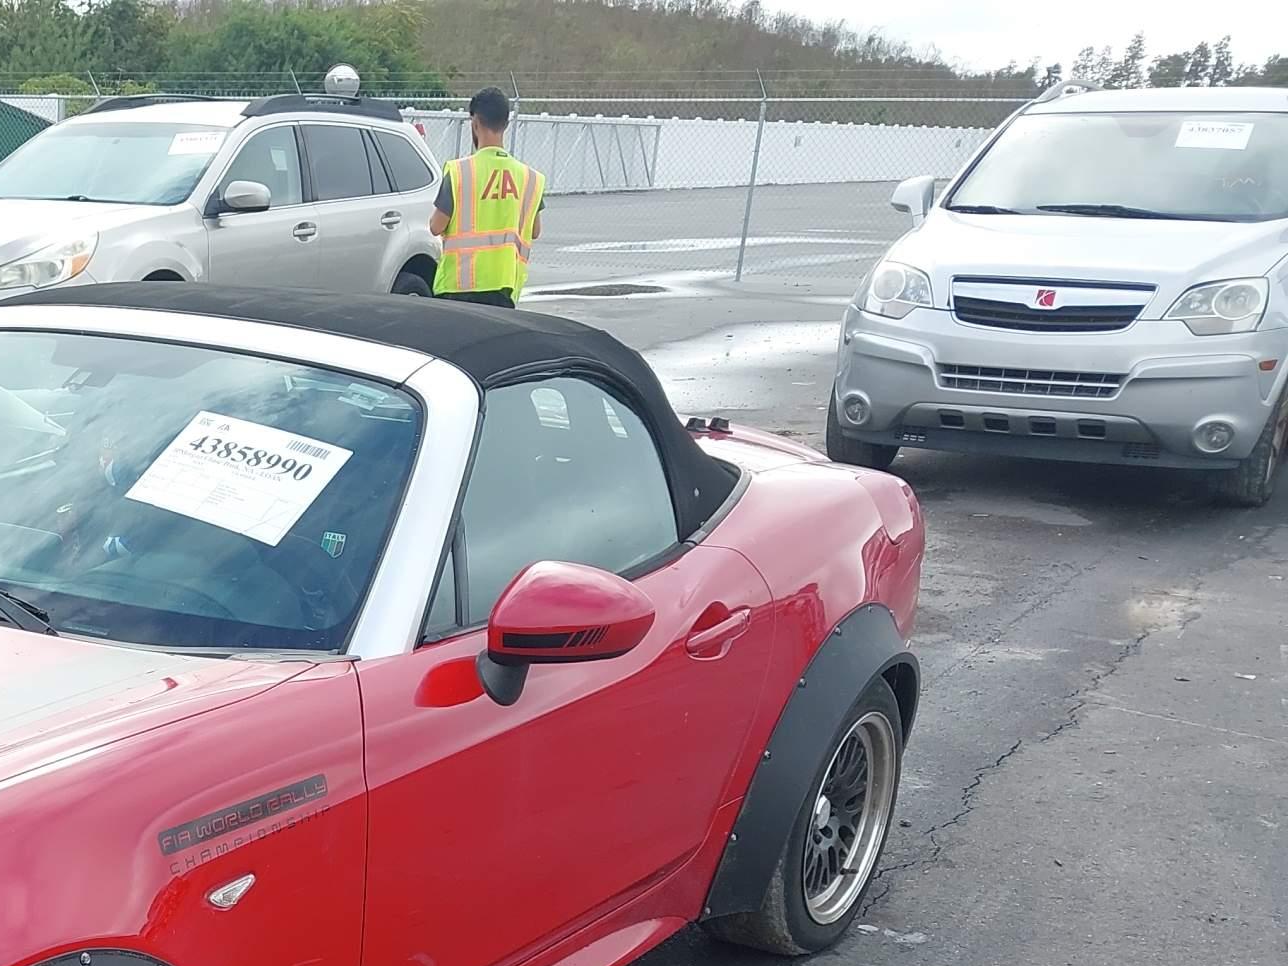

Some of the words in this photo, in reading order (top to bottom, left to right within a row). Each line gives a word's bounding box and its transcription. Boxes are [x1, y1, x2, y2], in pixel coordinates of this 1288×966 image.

[188, 434, 314, 482] 43858990
[162, 831, 191, 850] FIA
[196, 805, 262, 839] WORLD
[267, 782, 327, 814] RALLY
[169, 805, 330, 875] CHAMPIONSHIP
